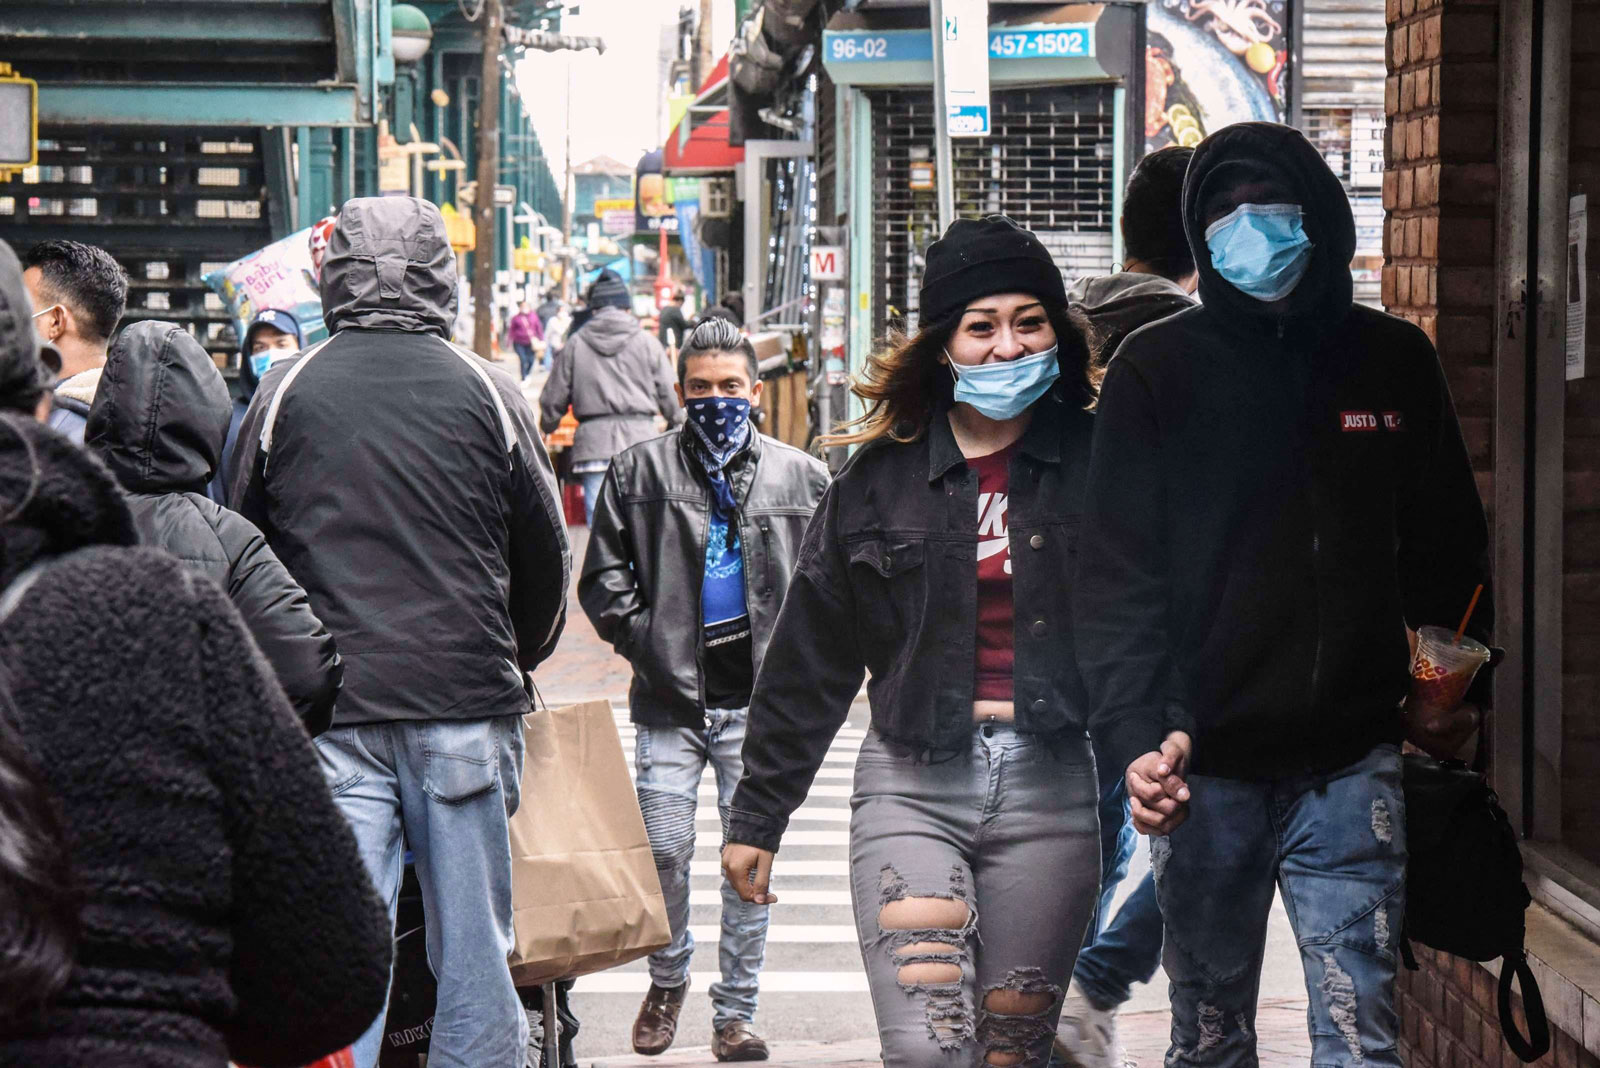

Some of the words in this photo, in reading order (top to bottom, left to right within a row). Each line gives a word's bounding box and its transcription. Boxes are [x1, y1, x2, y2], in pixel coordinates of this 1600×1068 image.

[832, 37, 887, 59] 96-02
[990, 32, 1083, 57] 457-1502
[815, 252, 835, 273] M
[1344, 414, 1368, 428] JUST
[1368, 414, 1377, 427] D
